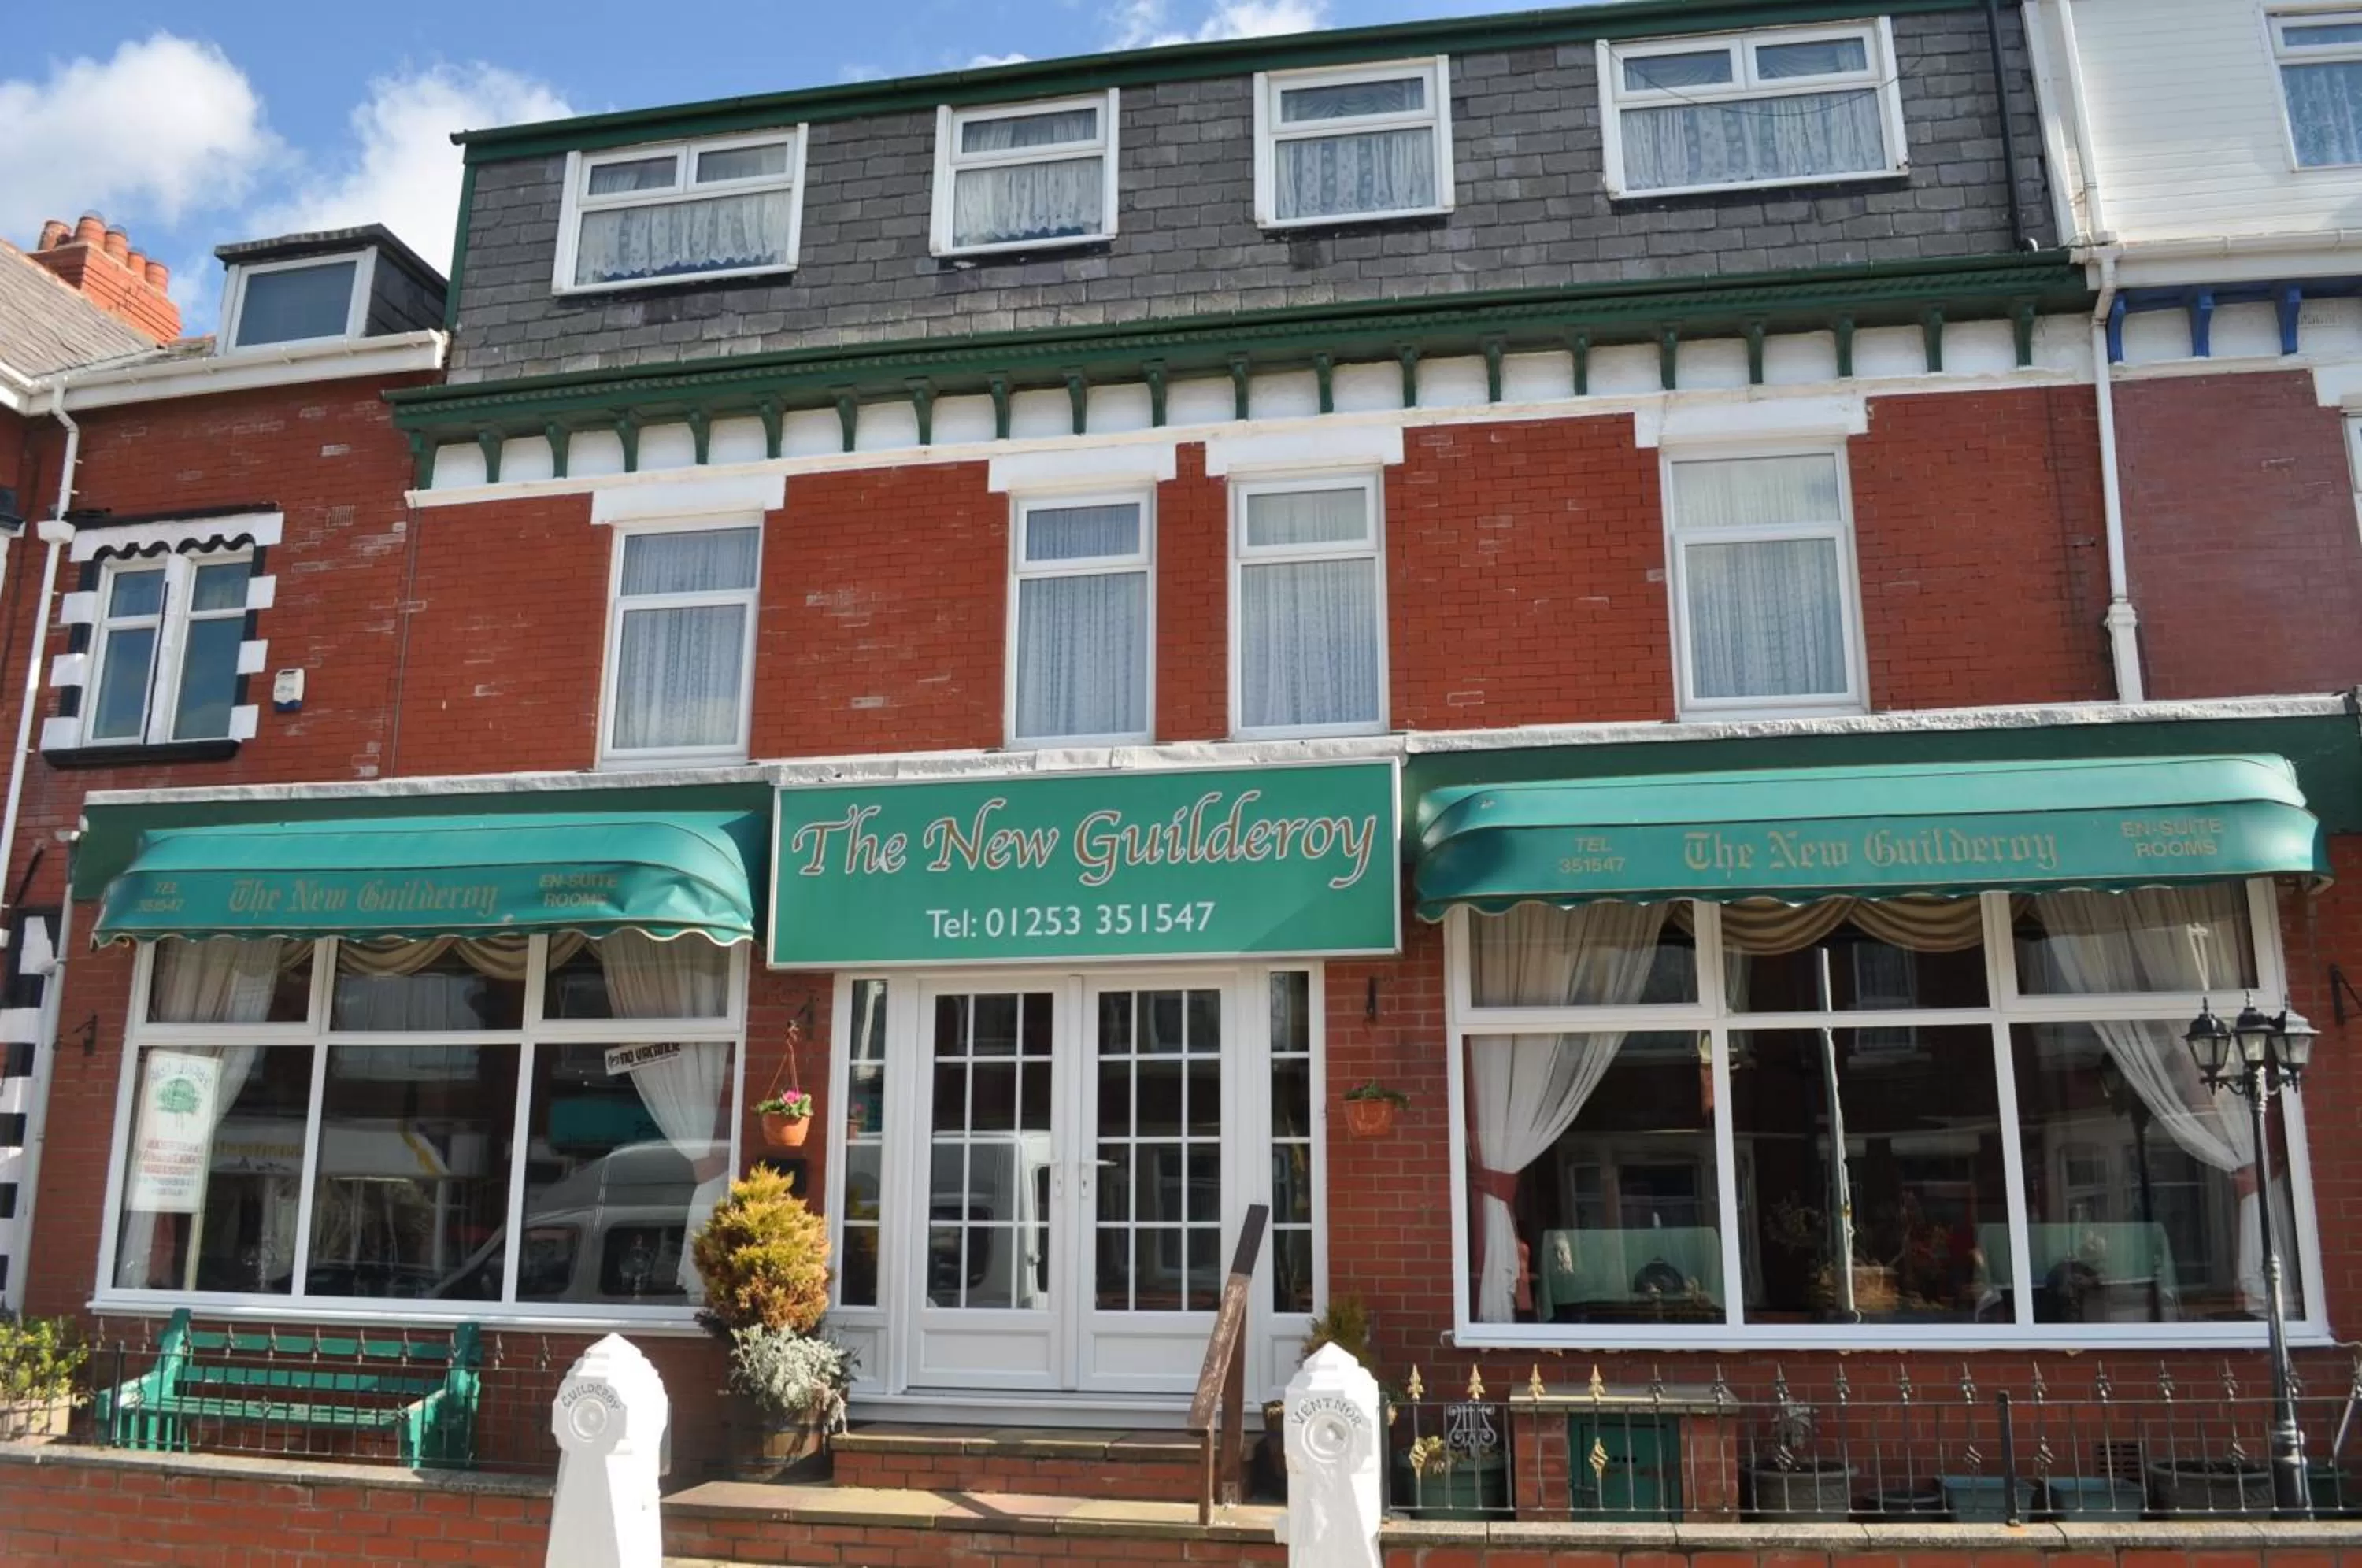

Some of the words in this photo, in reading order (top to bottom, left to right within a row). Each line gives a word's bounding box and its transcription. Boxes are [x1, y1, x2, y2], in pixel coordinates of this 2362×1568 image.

[792, 804, 908, 876] The
[923, 797, 1060, 873] New
[1072, 789, 1377, 889] Guilderoy
[1575, 837, 1612, 852] TEL
[1683, 830, 1754, 878] The
[1768, 830, 1849, 870] New
[1864, 826, 2060, 871] Guilderoy
[2134, 839, 2218, 857] ROOMS
[228, 878, 281, 919] The
[985, 905, 1081, 937] 01253
[1095, 901, 1216, 934] 351547
[561, 1383, 621, 1411] GUILDEROY
[1291, 1397, 1361, 1429] VENTNOR
